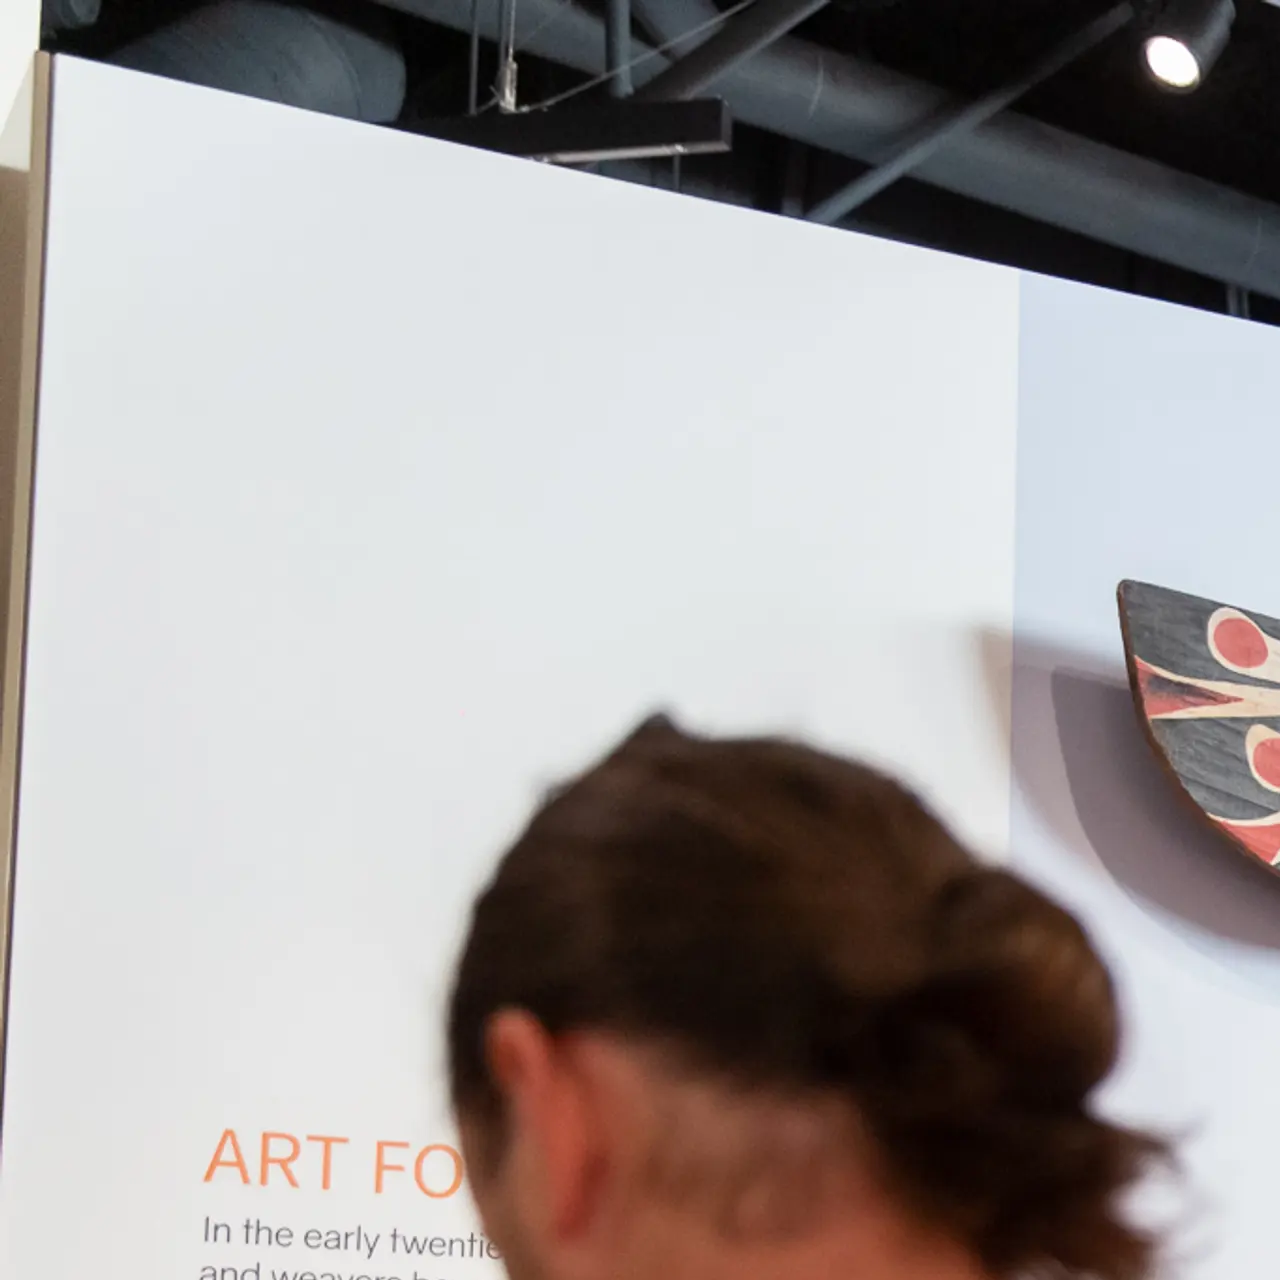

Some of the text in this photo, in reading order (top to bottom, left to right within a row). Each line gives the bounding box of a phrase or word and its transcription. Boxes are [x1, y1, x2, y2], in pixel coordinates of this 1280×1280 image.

[204, 1128, 346, 1190] ART
[203, 1215, 231, 1243] In
[243, 1218, 294, 1247] the
[303, 1221, 380, 1259] early
